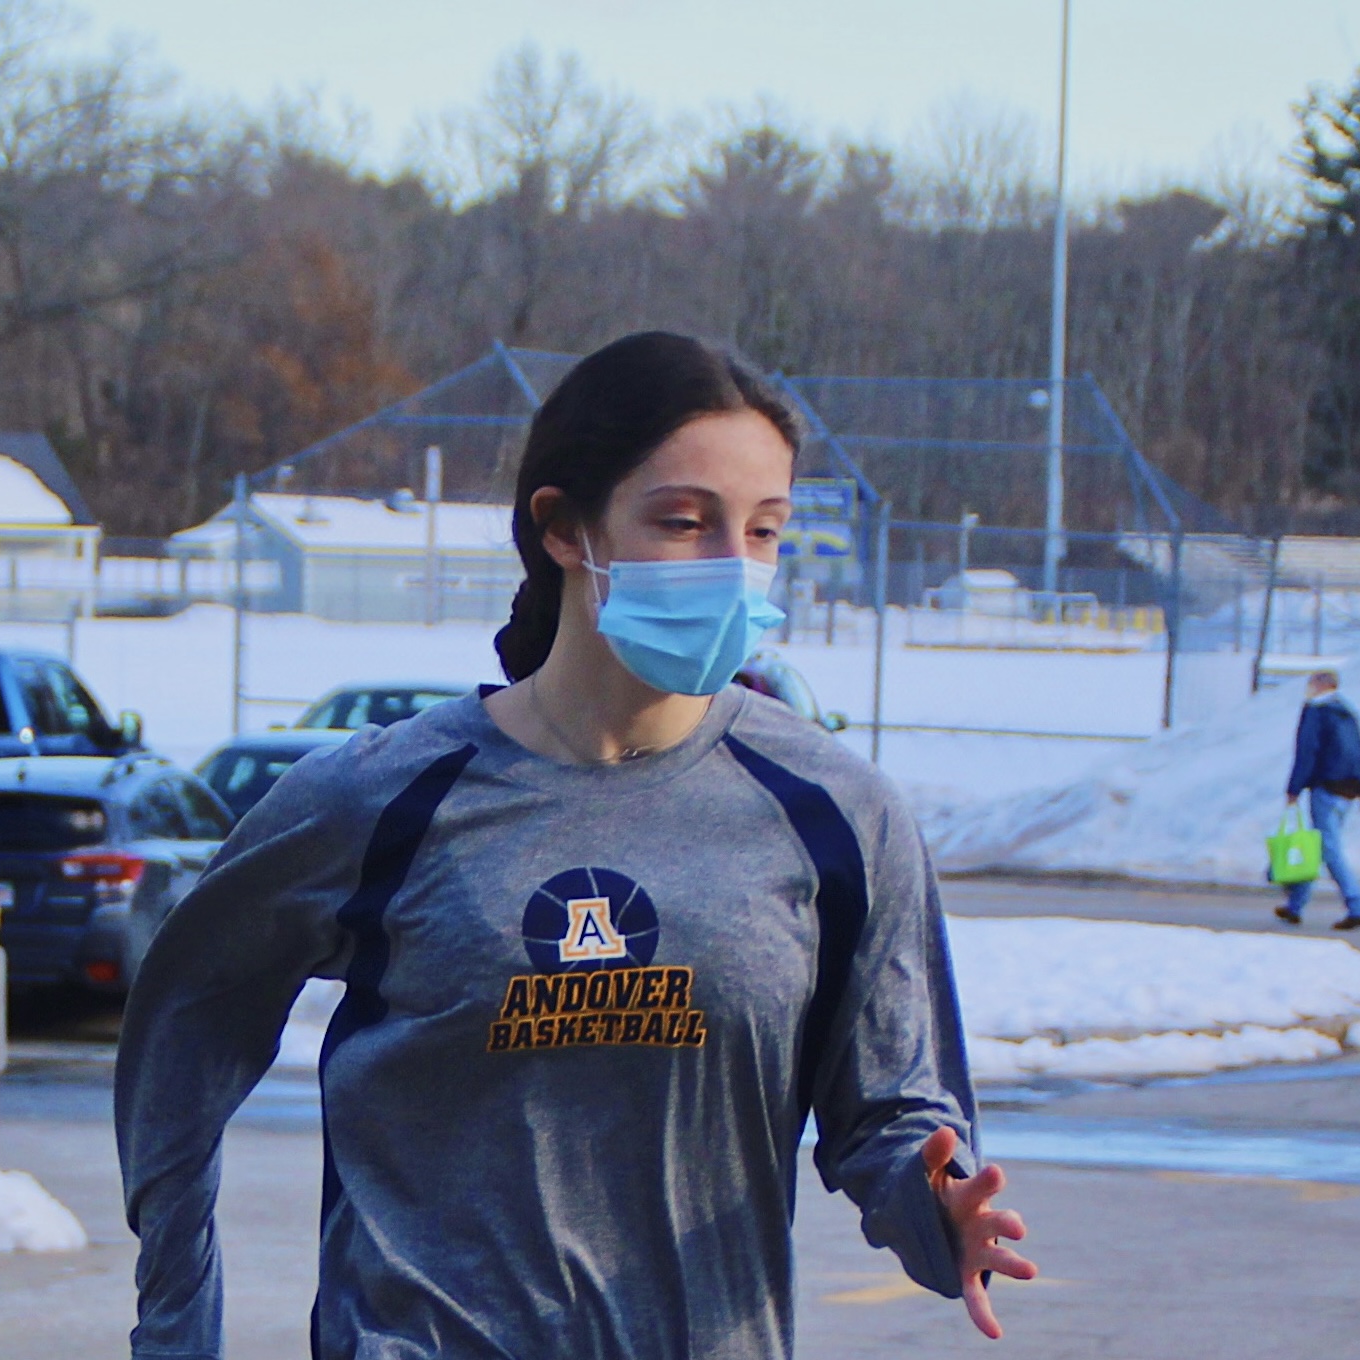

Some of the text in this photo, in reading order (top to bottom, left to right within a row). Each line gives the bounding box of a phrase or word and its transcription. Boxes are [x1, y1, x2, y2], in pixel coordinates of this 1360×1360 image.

[559, 897, 626, 962] A
[500, 966, 694, 1019] ANDOVER
[488, 1010, 707, 1051] BASKETBALL
